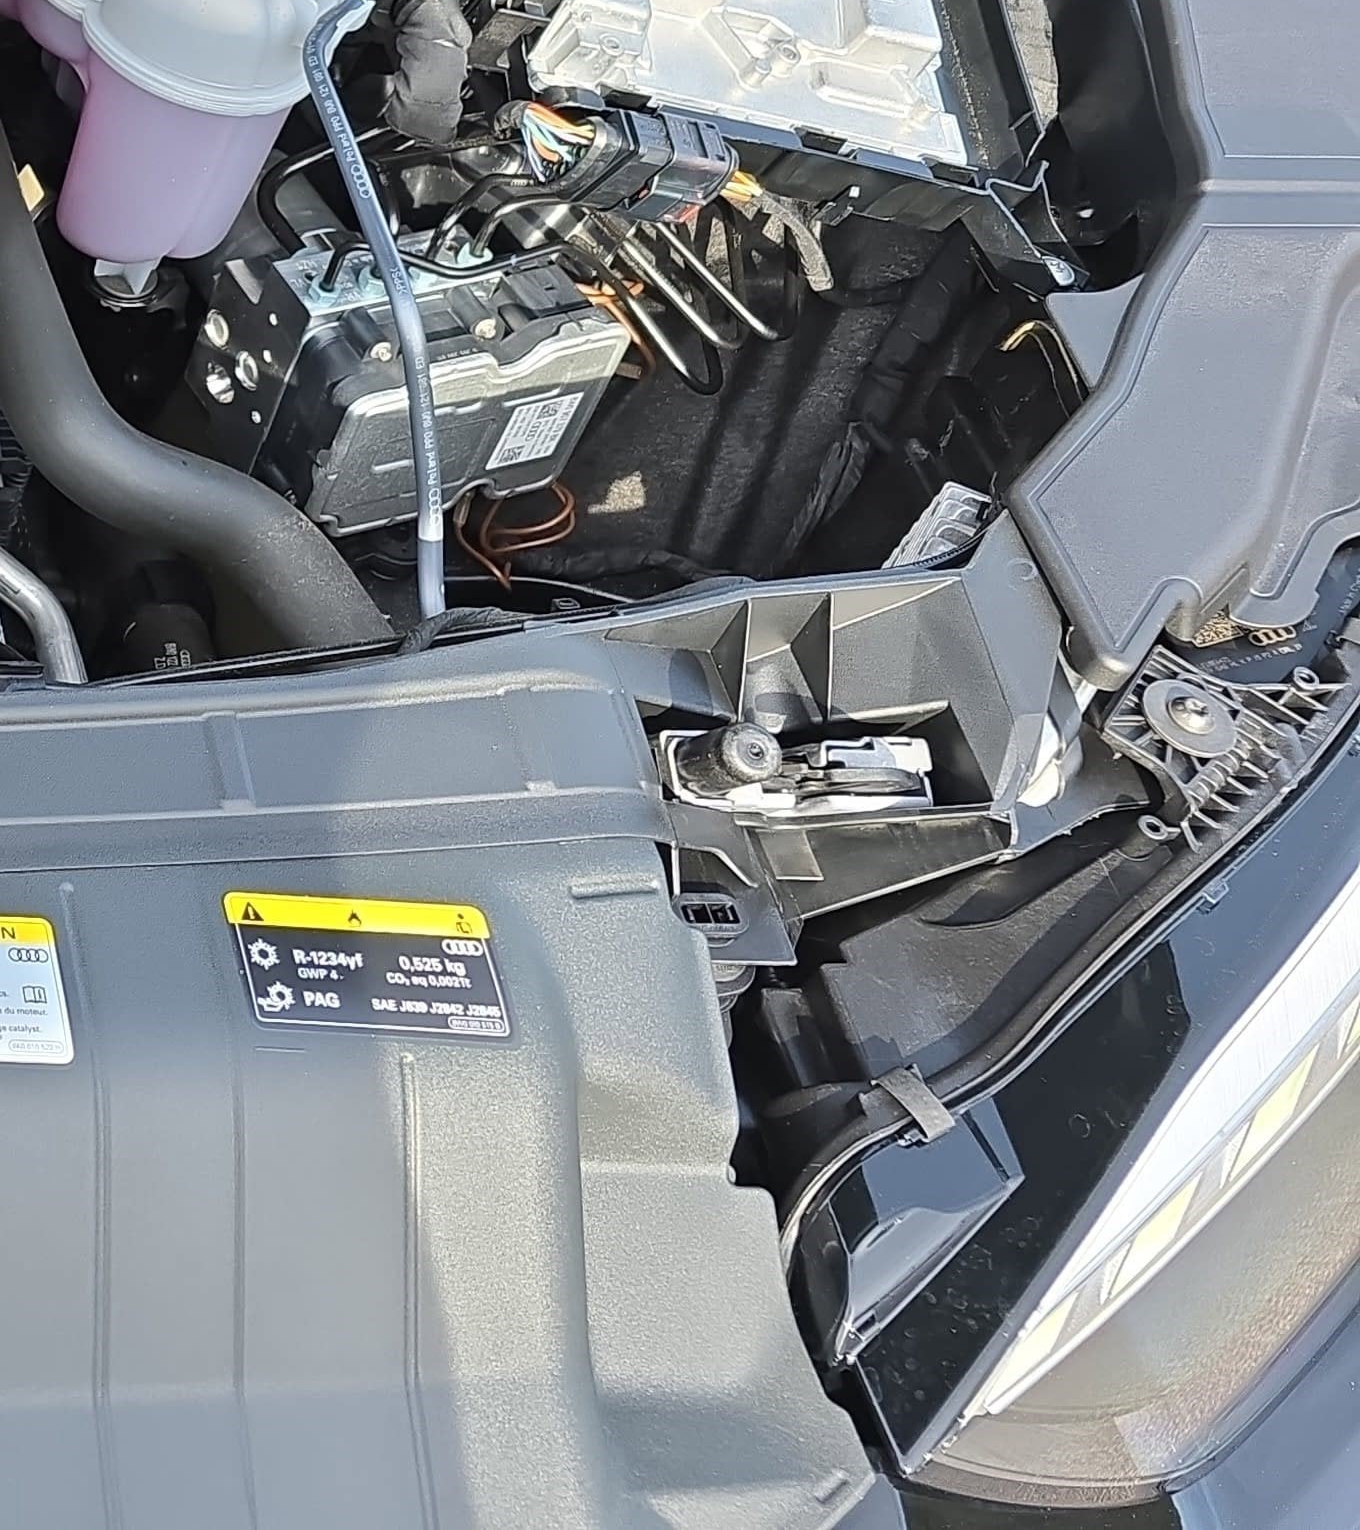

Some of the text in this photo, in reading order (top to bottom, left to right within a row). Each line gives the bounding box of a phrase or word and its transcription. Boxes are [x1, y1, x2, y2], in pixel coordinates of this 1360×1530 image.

[307, 55, 320, 67] ED
[317, 83, 331, 98] 121
[329, 115, 344, 132] PPO
[336, 132, 356, 164] Poland
[420, 394, 431, 407] 121
[424, 432, 434, 448] PPO
[425, 452, 437, 484] Poland
[292, 949, 363, 970] R-1234yf
[399, 956, 466, 976] 0,525 kg
[298, 967, 328, 979] GWP
[411, 976, 428, 988] eq
[303, 990, 340, 1008] PAG
[371, 998, 398, 1011] SAE
[400, 1000, 428, 1013] J639
